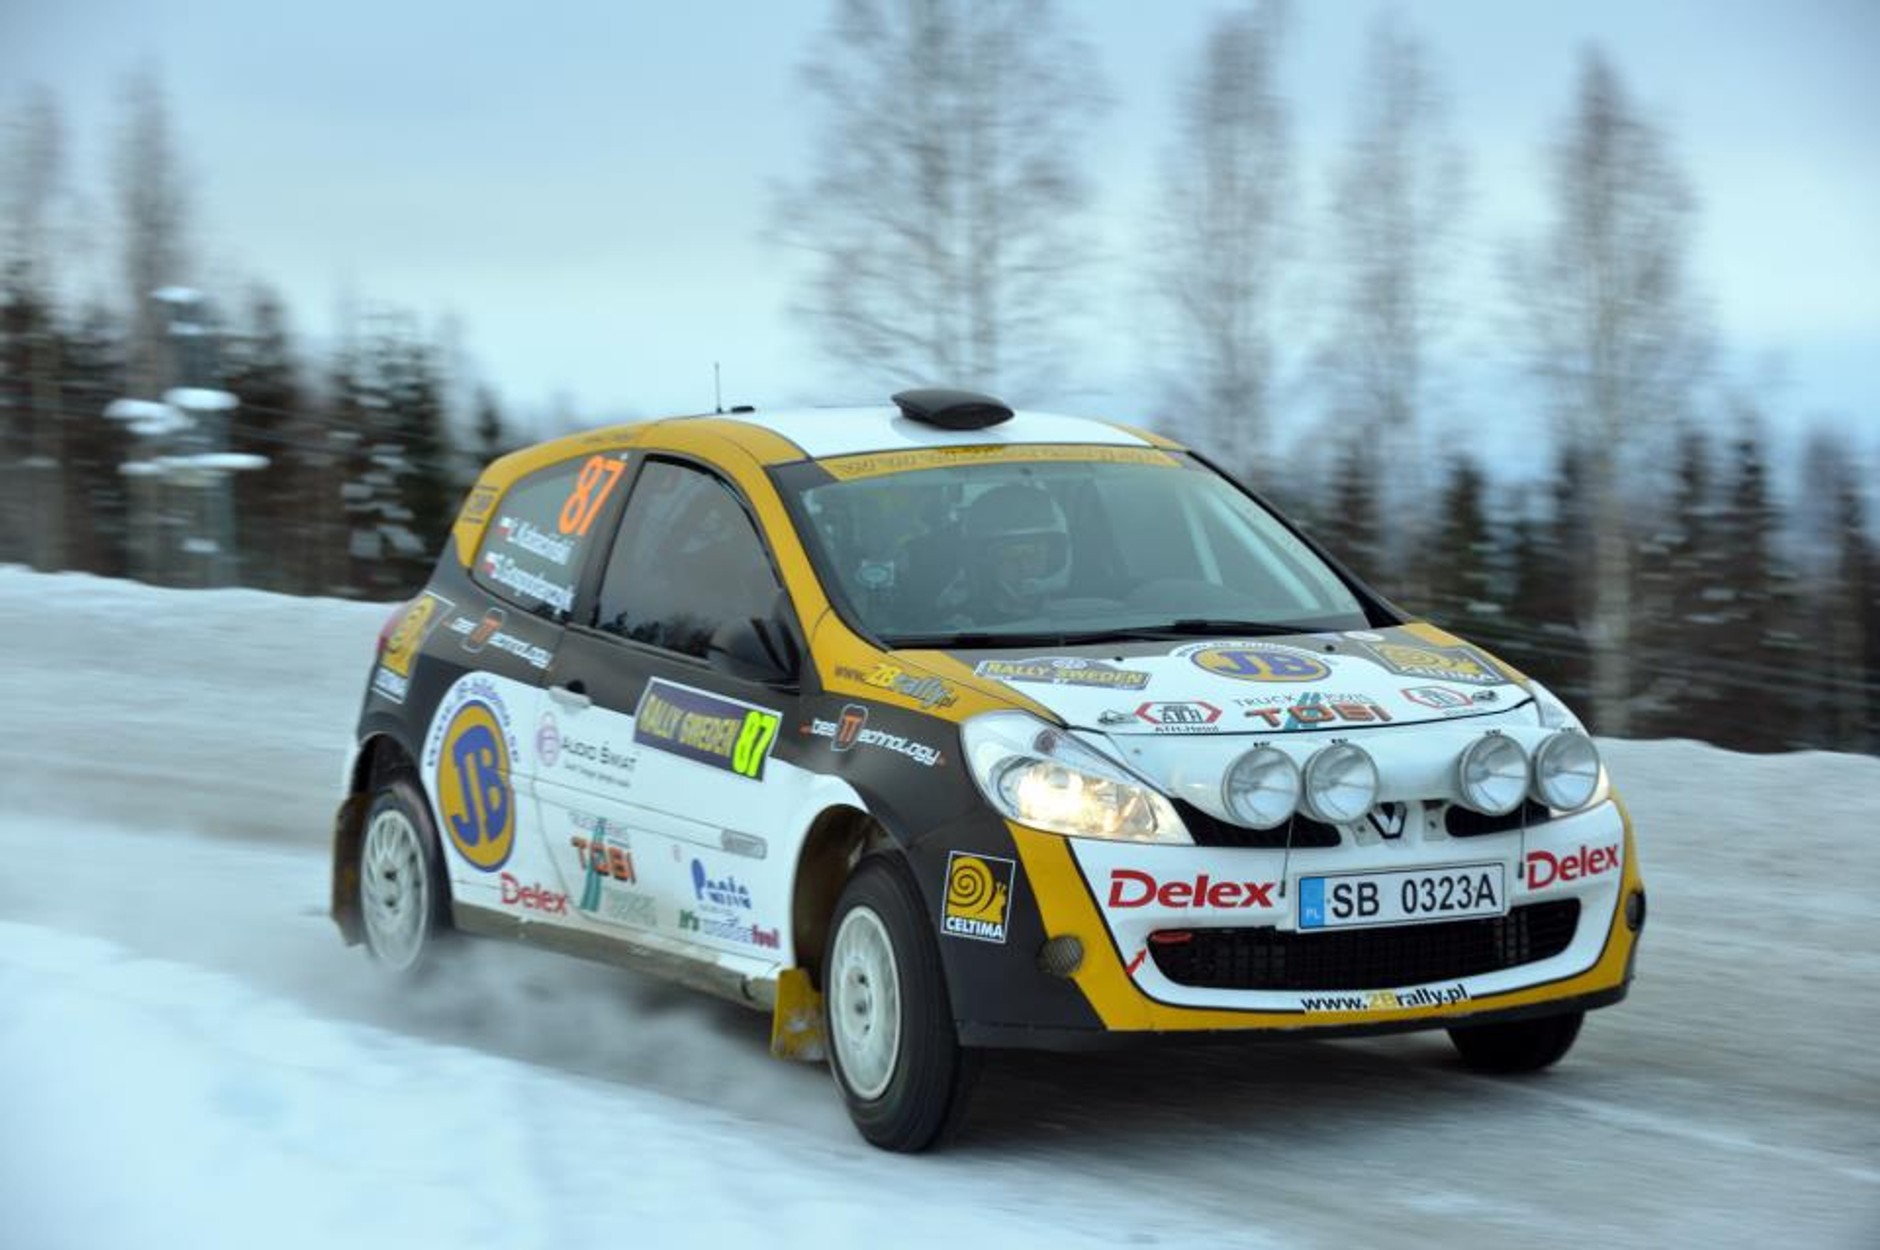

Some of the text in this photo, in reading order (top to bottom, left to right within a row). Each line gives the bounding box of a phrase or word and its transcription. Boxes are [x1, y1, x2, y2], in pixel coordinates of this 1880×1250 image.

[559, 455, 627, 537] 87
[985, 661, 1144, 687] RALLY SWEDEN
[1214, 651, 1320, 676] JB
[732, 710, 778, 778] 87
[450, 725, 508, 848] JB
[1107, 869, 1276, 909] Delex
[1526, 844, 1620, 890] Delex
[501, 871, 567, 916] Delex
[1305, 908, 1321, 920] PL
[1331, 872, 1498, 919] SB 0323A
[945, 917, 1005, 940] CELTIMA
